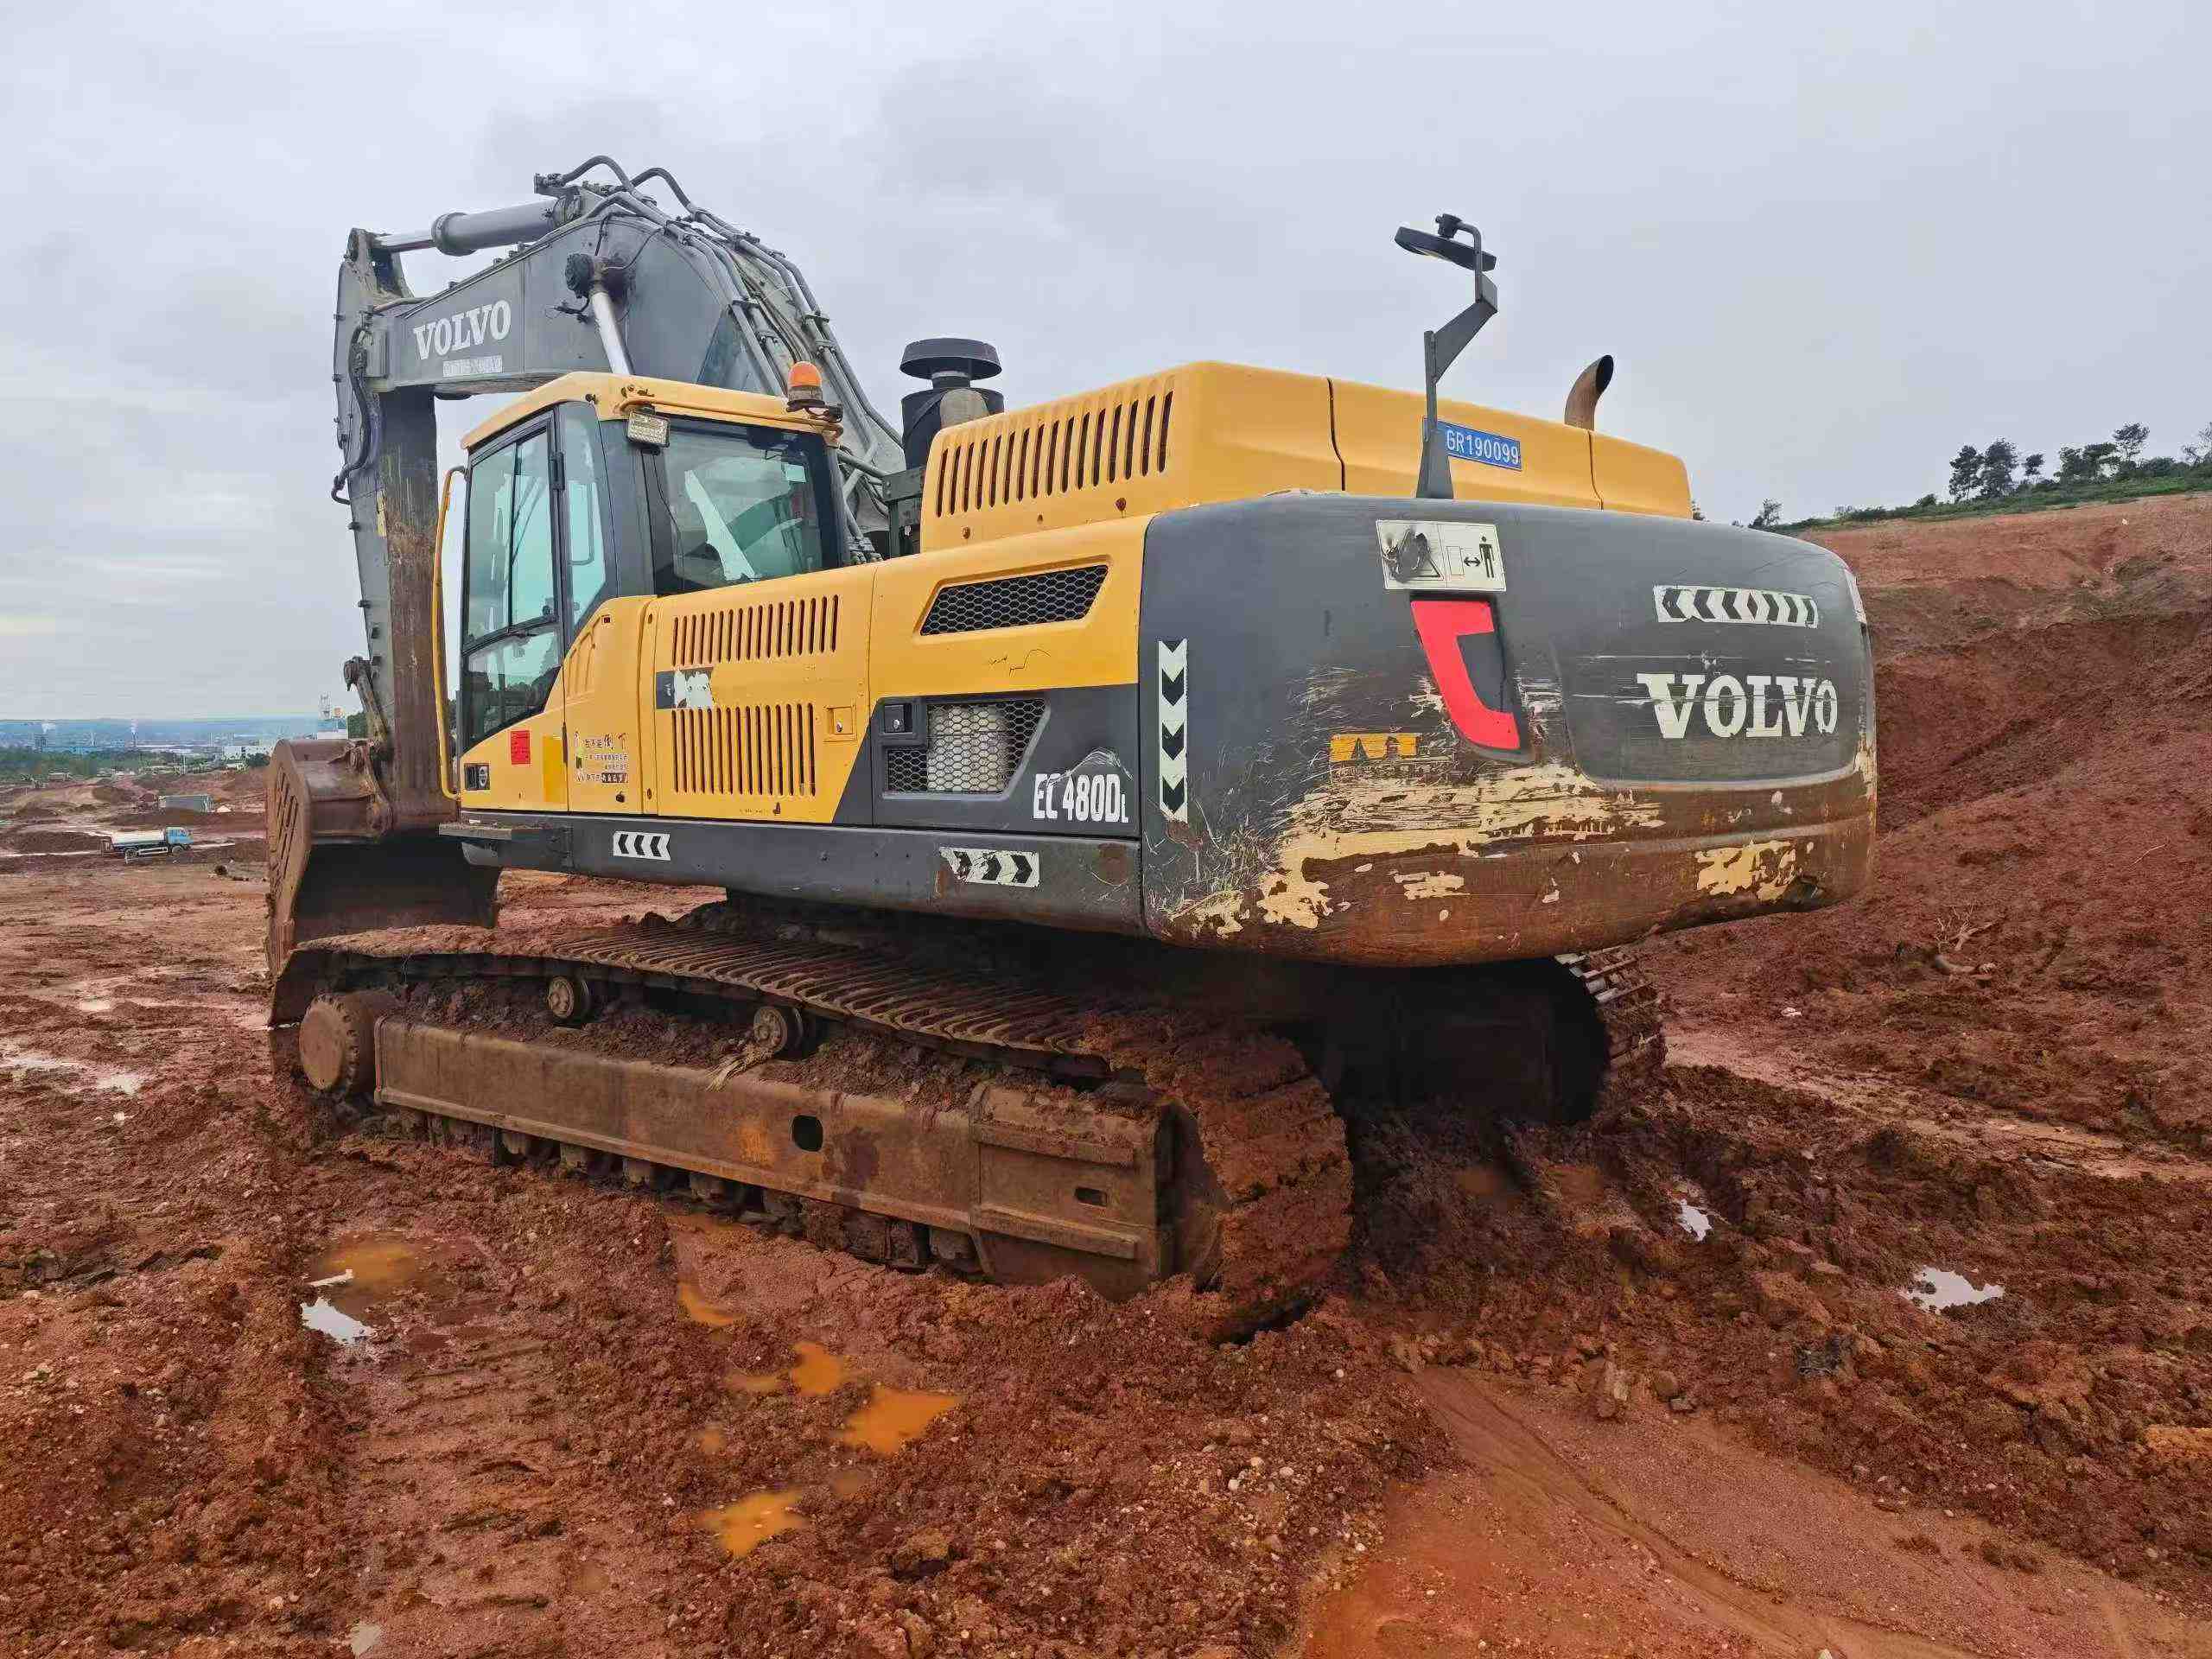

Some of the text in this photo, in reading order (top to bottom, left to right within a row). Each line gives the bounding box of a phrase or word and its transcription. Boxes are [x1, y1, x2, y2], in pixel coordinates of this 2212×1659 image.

[413, 300, 512, 359] VOLVO
[1446, 429, 1519, 465] GR190099
[1637, 673, 1838, 739] VOLVO
